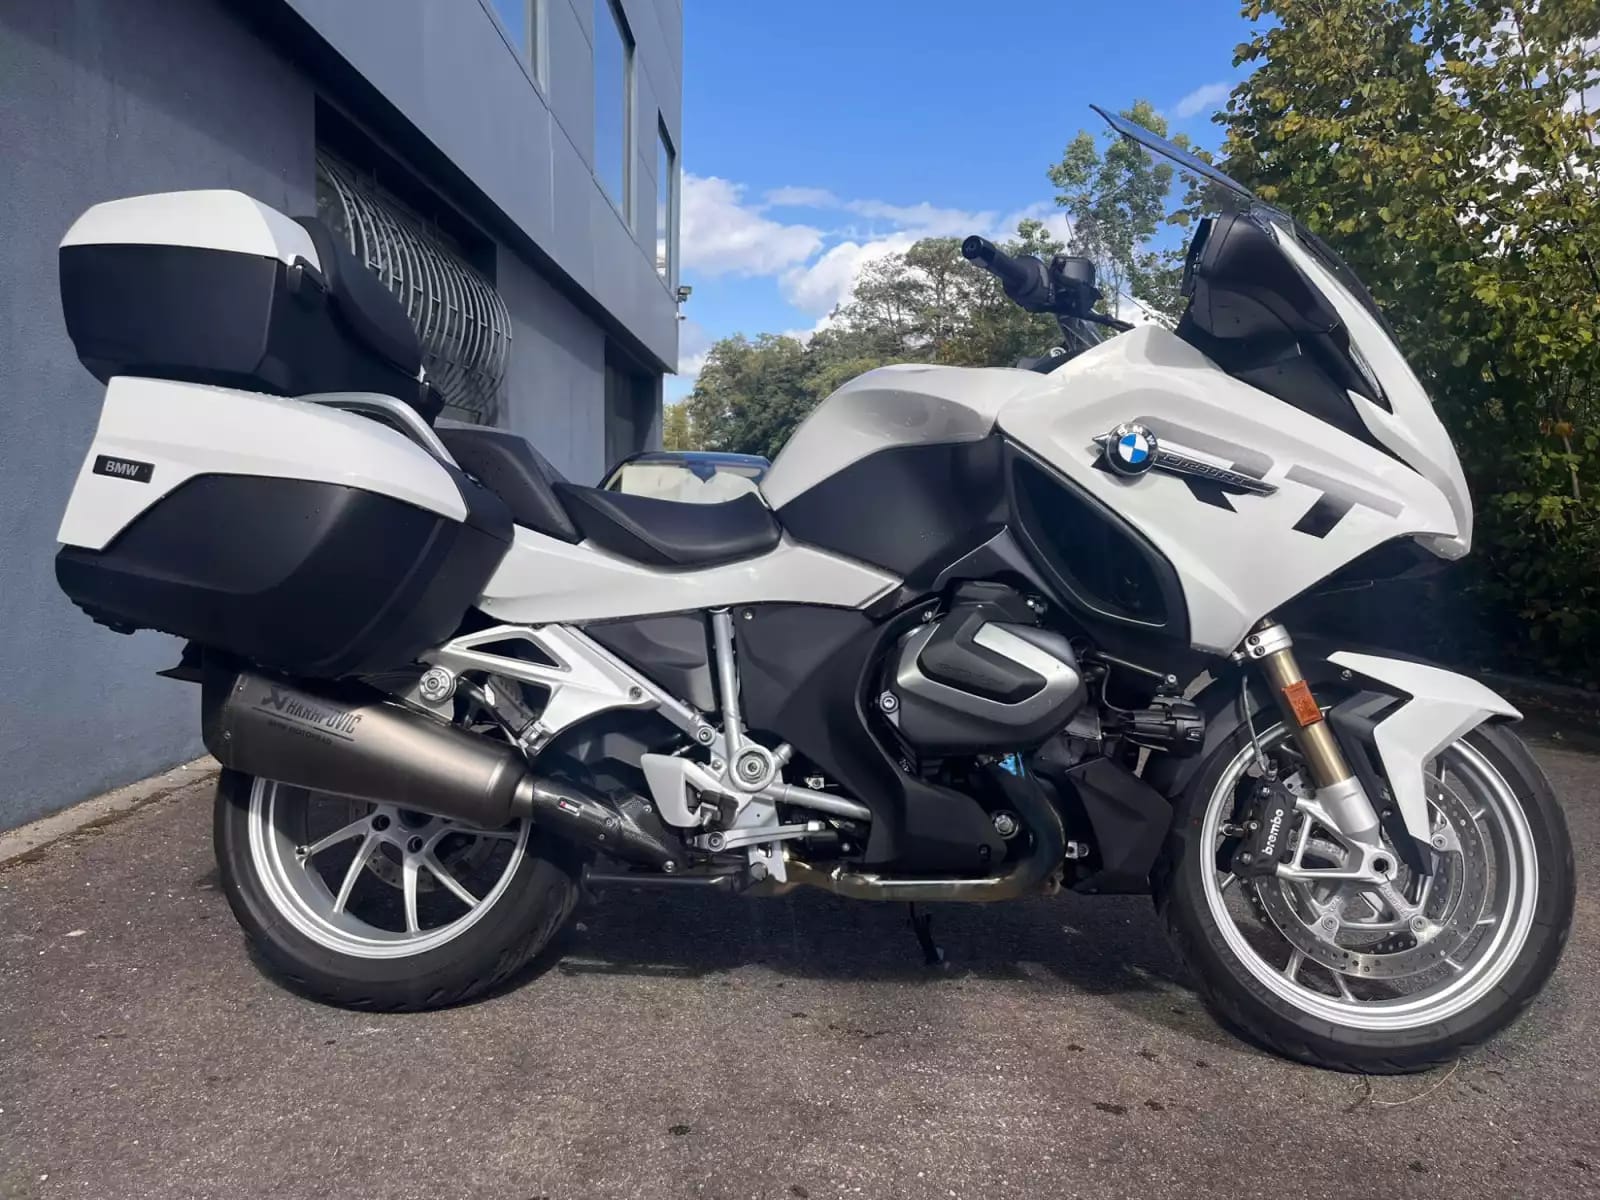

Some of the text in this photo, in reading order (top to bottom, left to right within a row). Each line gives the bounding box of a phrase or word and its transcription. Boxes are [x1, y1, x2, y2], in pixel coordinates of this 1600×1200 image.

[1116, 423, 1156, 446] BMW
[105, 460, 139, 477] BMW
[1261, 808, 1284, 856] brembo
